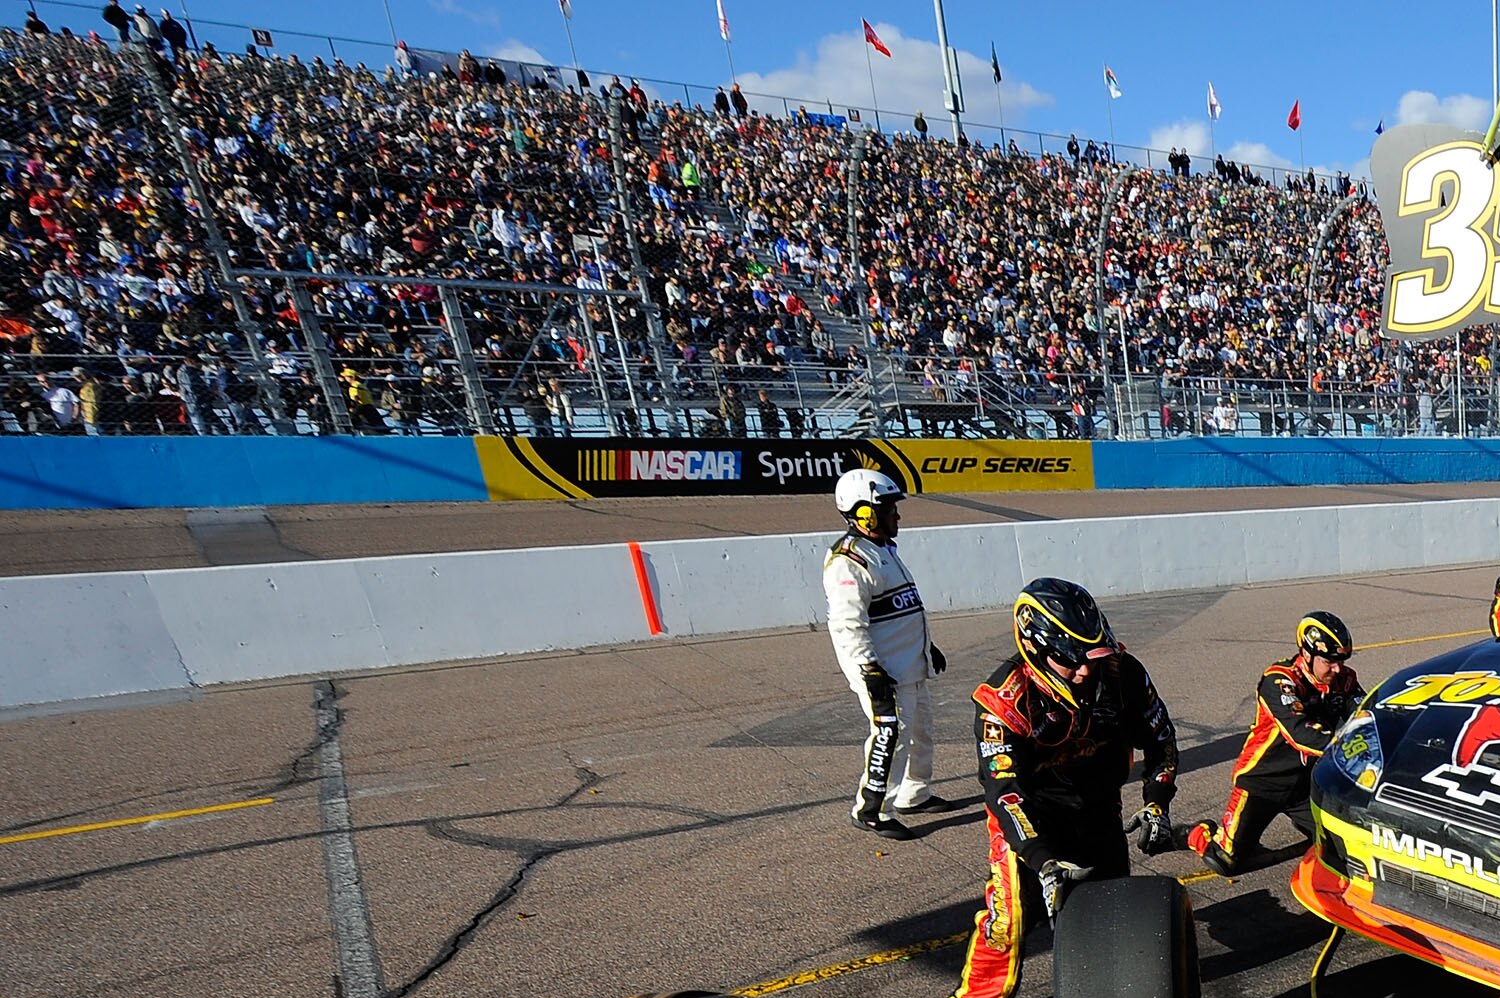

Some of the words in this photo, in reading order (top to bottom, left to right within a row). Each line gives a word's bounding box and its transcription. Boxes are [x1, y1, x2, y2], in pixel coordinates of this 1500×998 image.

[630, 449, 737, 481] NASCAR
[757, 450, 843, 485] Sprint
[921, 456, 978, 474] CUP
[982, 457, 1071, 474] SERIES
[1486, 698, 1500, 706] A
[869, 726, 893, 776] Sprint
[1342, 733, 1369, 760] 39
